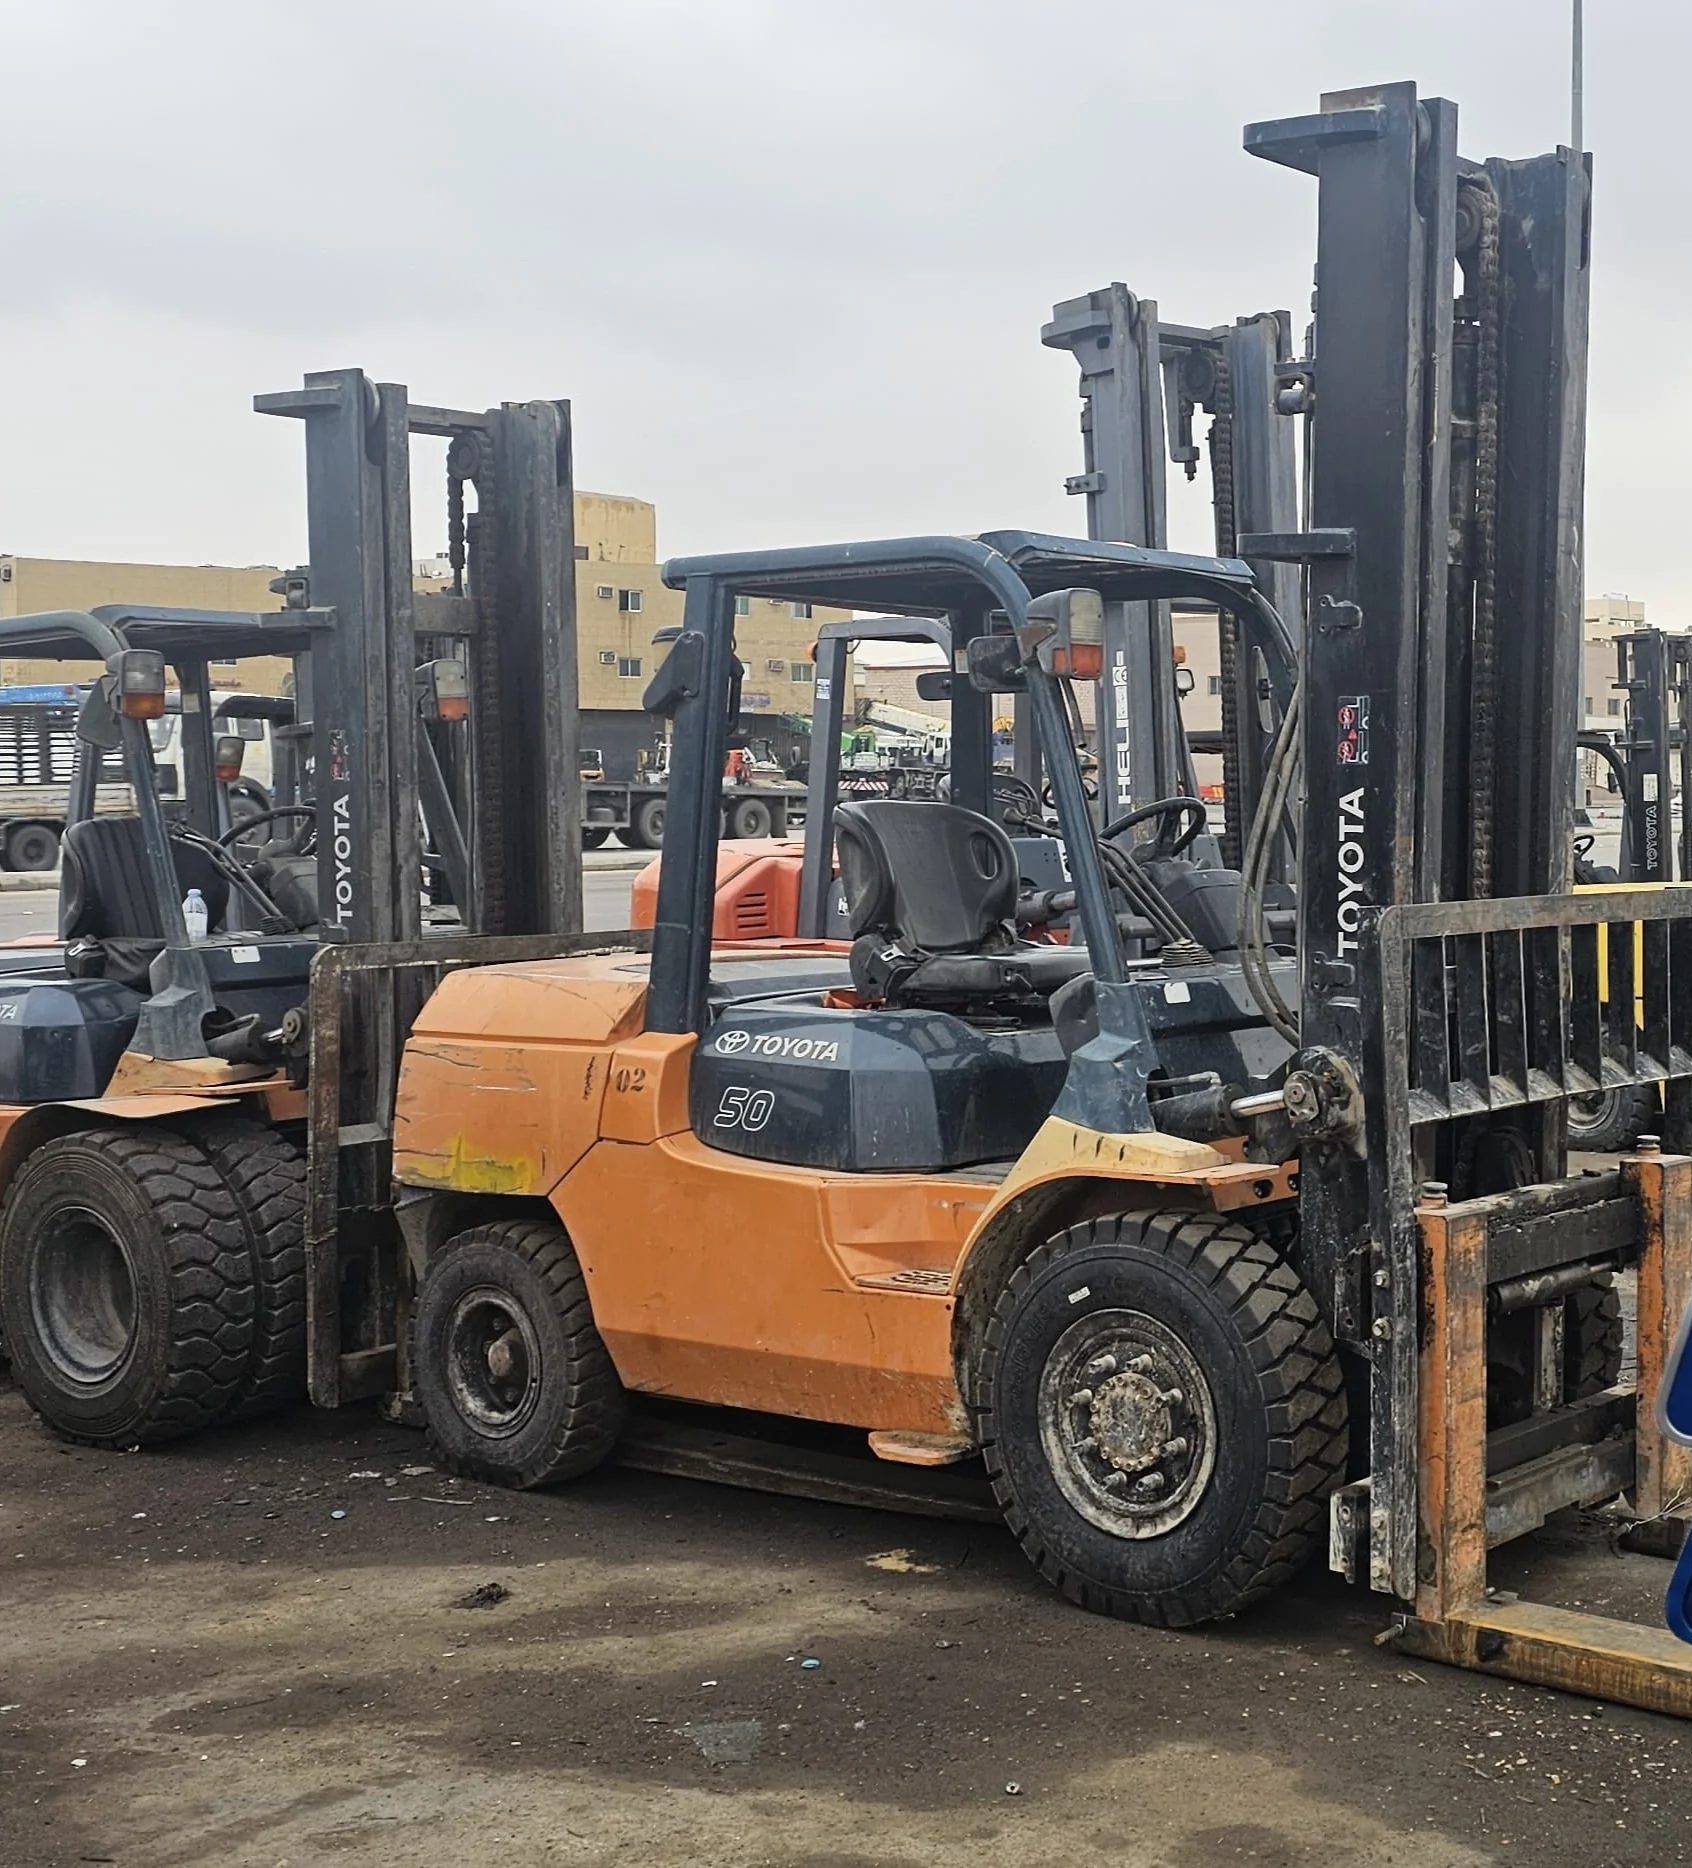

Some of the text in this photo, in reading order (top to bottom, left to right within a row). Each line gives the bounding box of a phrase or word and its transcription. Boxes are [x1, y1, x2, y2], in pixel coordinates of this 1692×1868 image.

[1116, 719, 1131, 805] HELI
[333, 794, 353, 924] TOYOTA
[1645, 805, 1658, 870] TOYOTA
[1337, 787, 1365, 958] TOYOTA
[615, 1067, 647, 1093] 02
[750, 1035, 839, 1062] TOYOTA
[713, 1086, 775, 1132] 50
